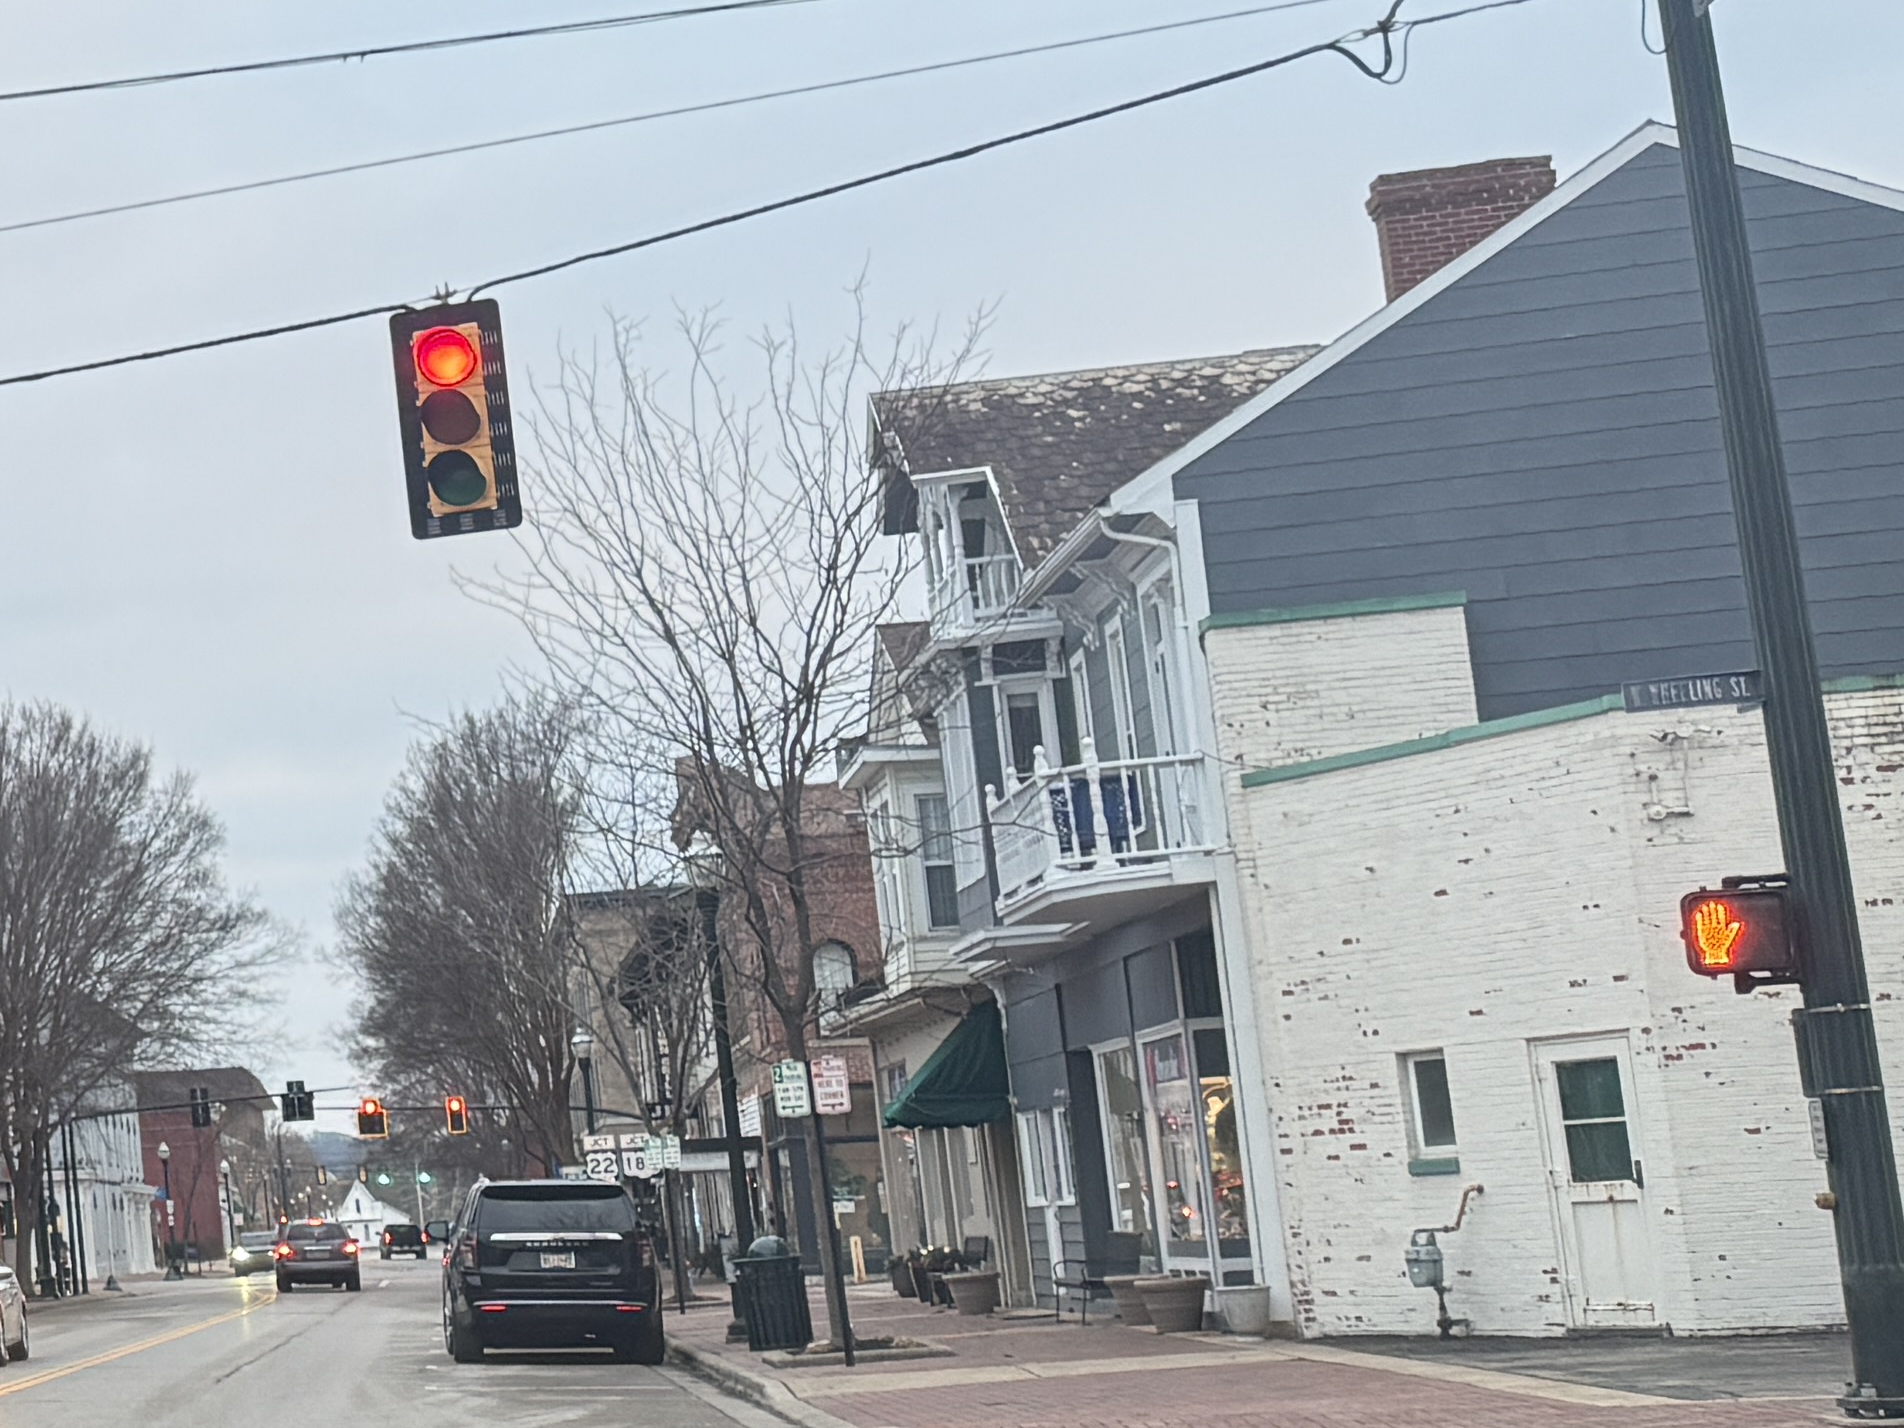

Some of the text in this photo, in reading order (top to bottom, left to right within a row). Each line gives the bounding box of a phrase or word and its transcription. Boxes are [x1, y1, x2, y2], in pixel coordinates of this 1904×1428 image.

[590, 1137, 608, 1147] JCT
[626, 1136, 645, 1145] JCT
[590, 1157, 615, 1174] 22
